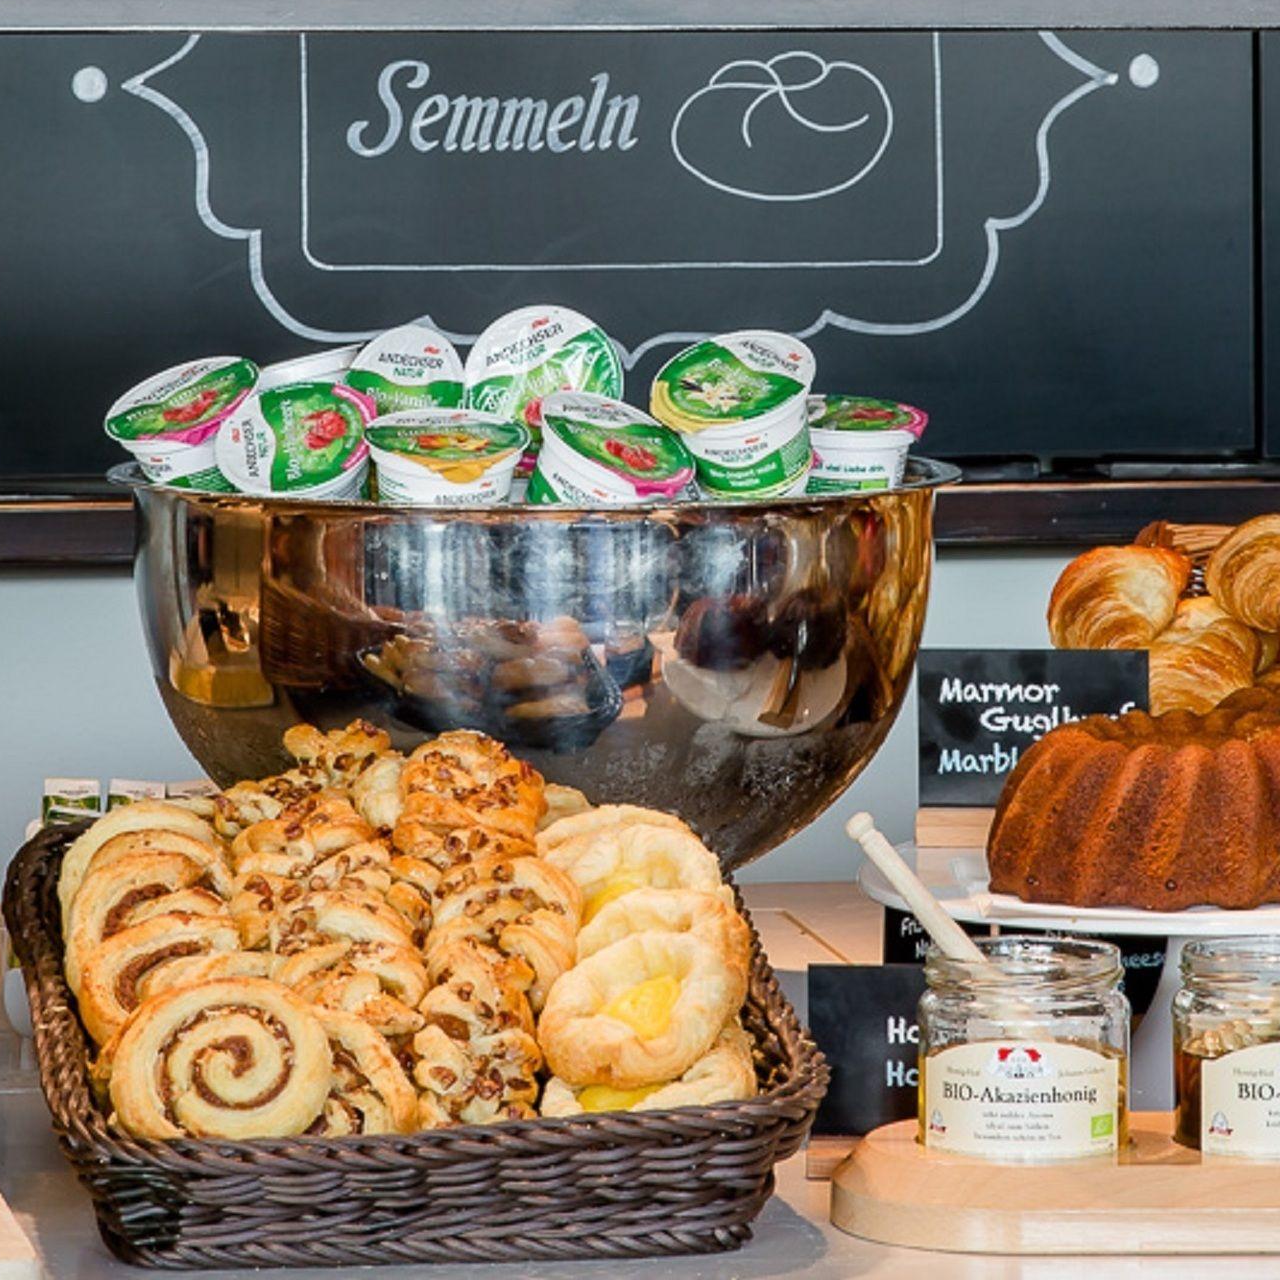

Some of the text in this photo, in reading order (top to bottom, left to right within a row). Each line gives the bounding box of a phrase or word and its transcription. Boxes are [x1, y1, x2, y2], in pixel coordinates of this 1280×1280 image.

[346, 59, 640, 157] Semmeln
[939, 677, 1061, 705] Marmor
[942, 1081, 1098, 1104] BIO-Akazienhonig
